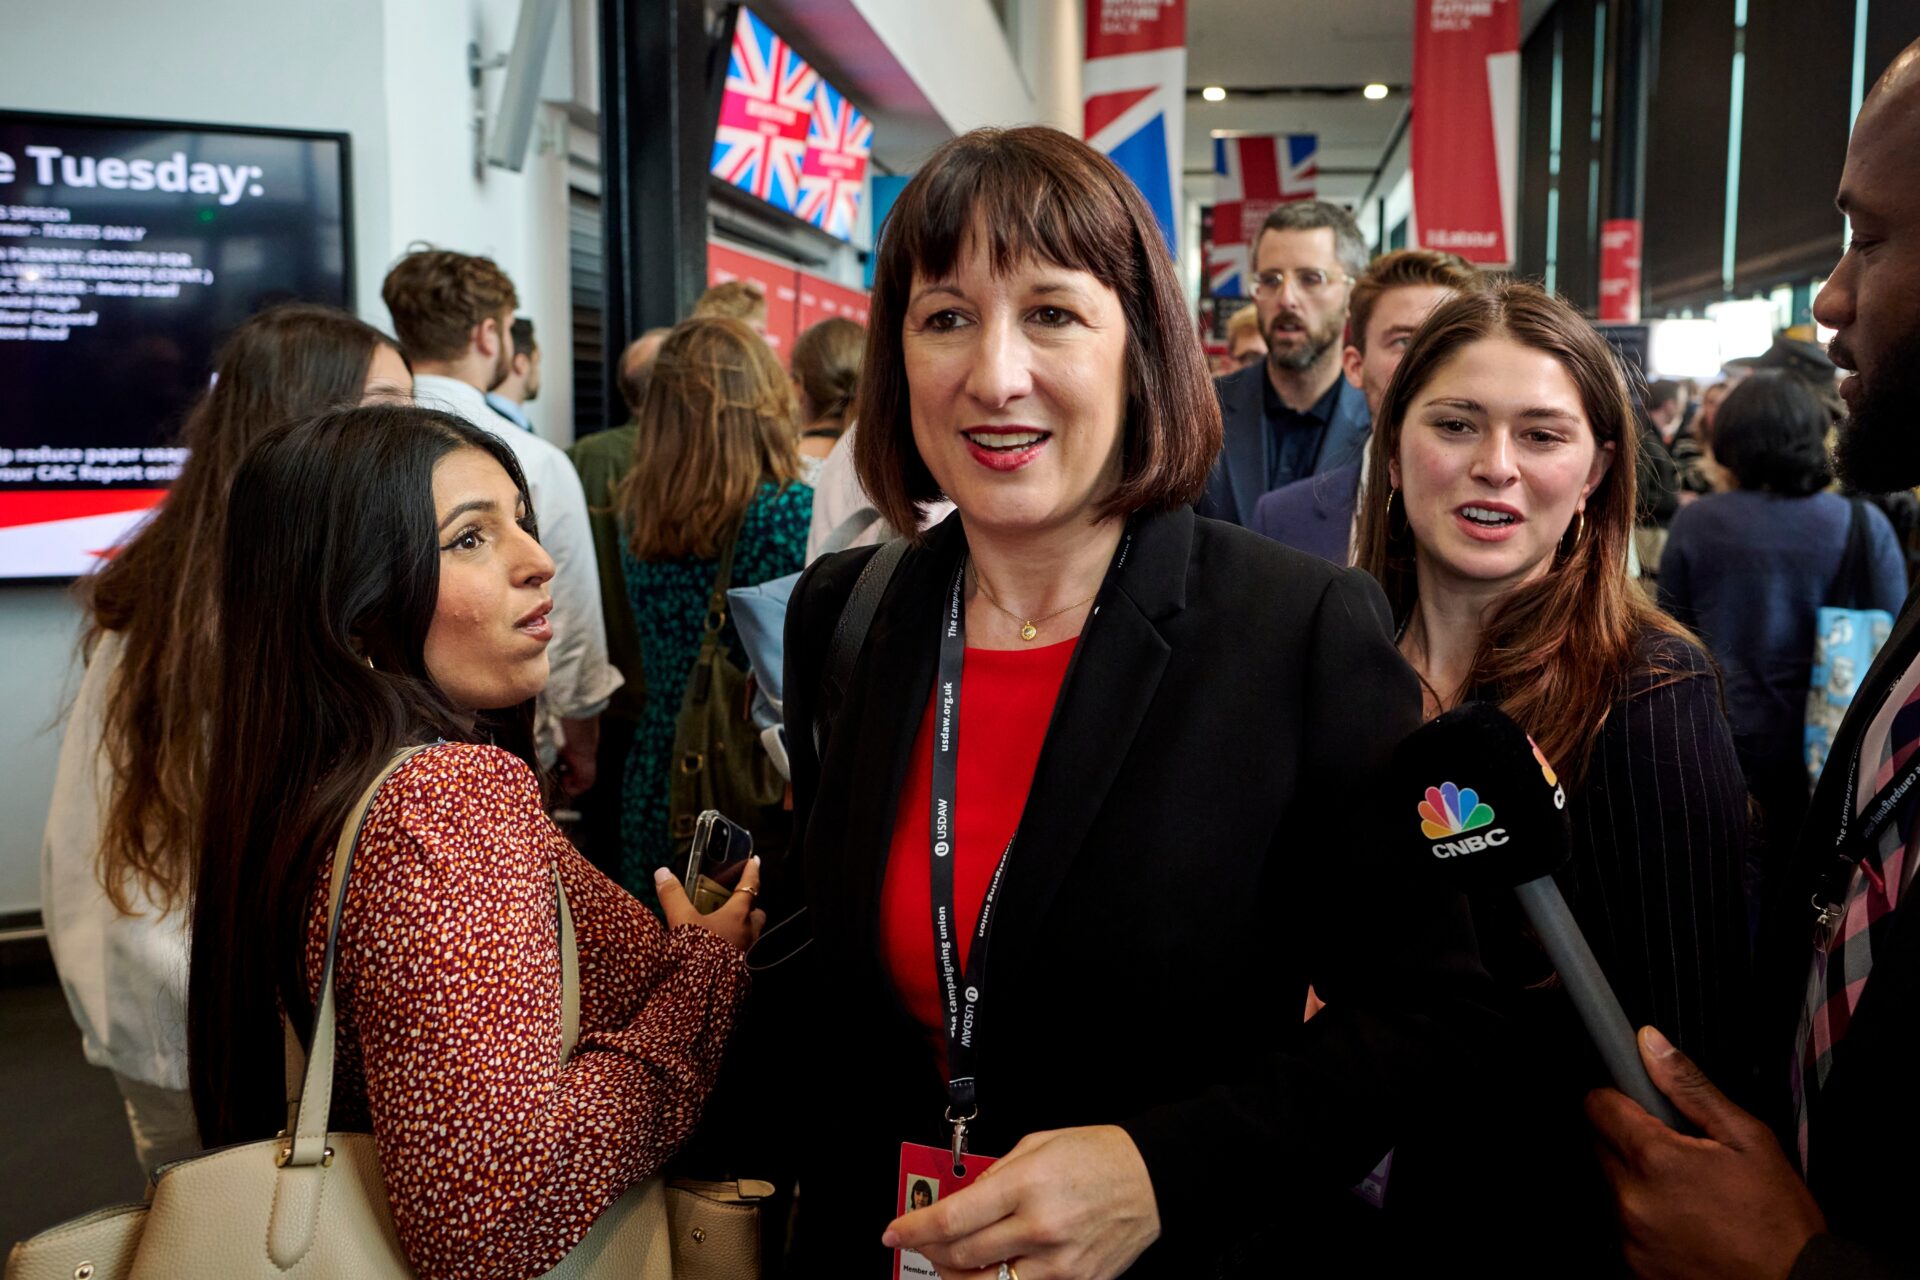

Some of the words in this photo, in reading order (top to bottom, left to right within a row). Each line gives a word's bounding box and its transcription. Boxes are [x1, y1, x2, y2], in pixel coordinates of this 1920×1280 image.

[26, 145, 264, 205] Tuesday:
[15, 445, 83, 463] reduce
[85, 448, 141, 466] paper
[36, 464, 77, 481] CAC
[78, 464, 143, 484] Report
[947, 620, 958, 638] The
[941, 682, 954, 752] usdaw.org.uk
[937, 798, 949, 840] USDAW
[1432, 828, 1510, 859] CNBC
[938, 905, 949, 940] union
[978, 904, 991, 938] union
[940, 940, 958, 1013] campaigning
[961, 1004, 975, 1048] USDAW
[903, 1265, 928, 1276] Member
